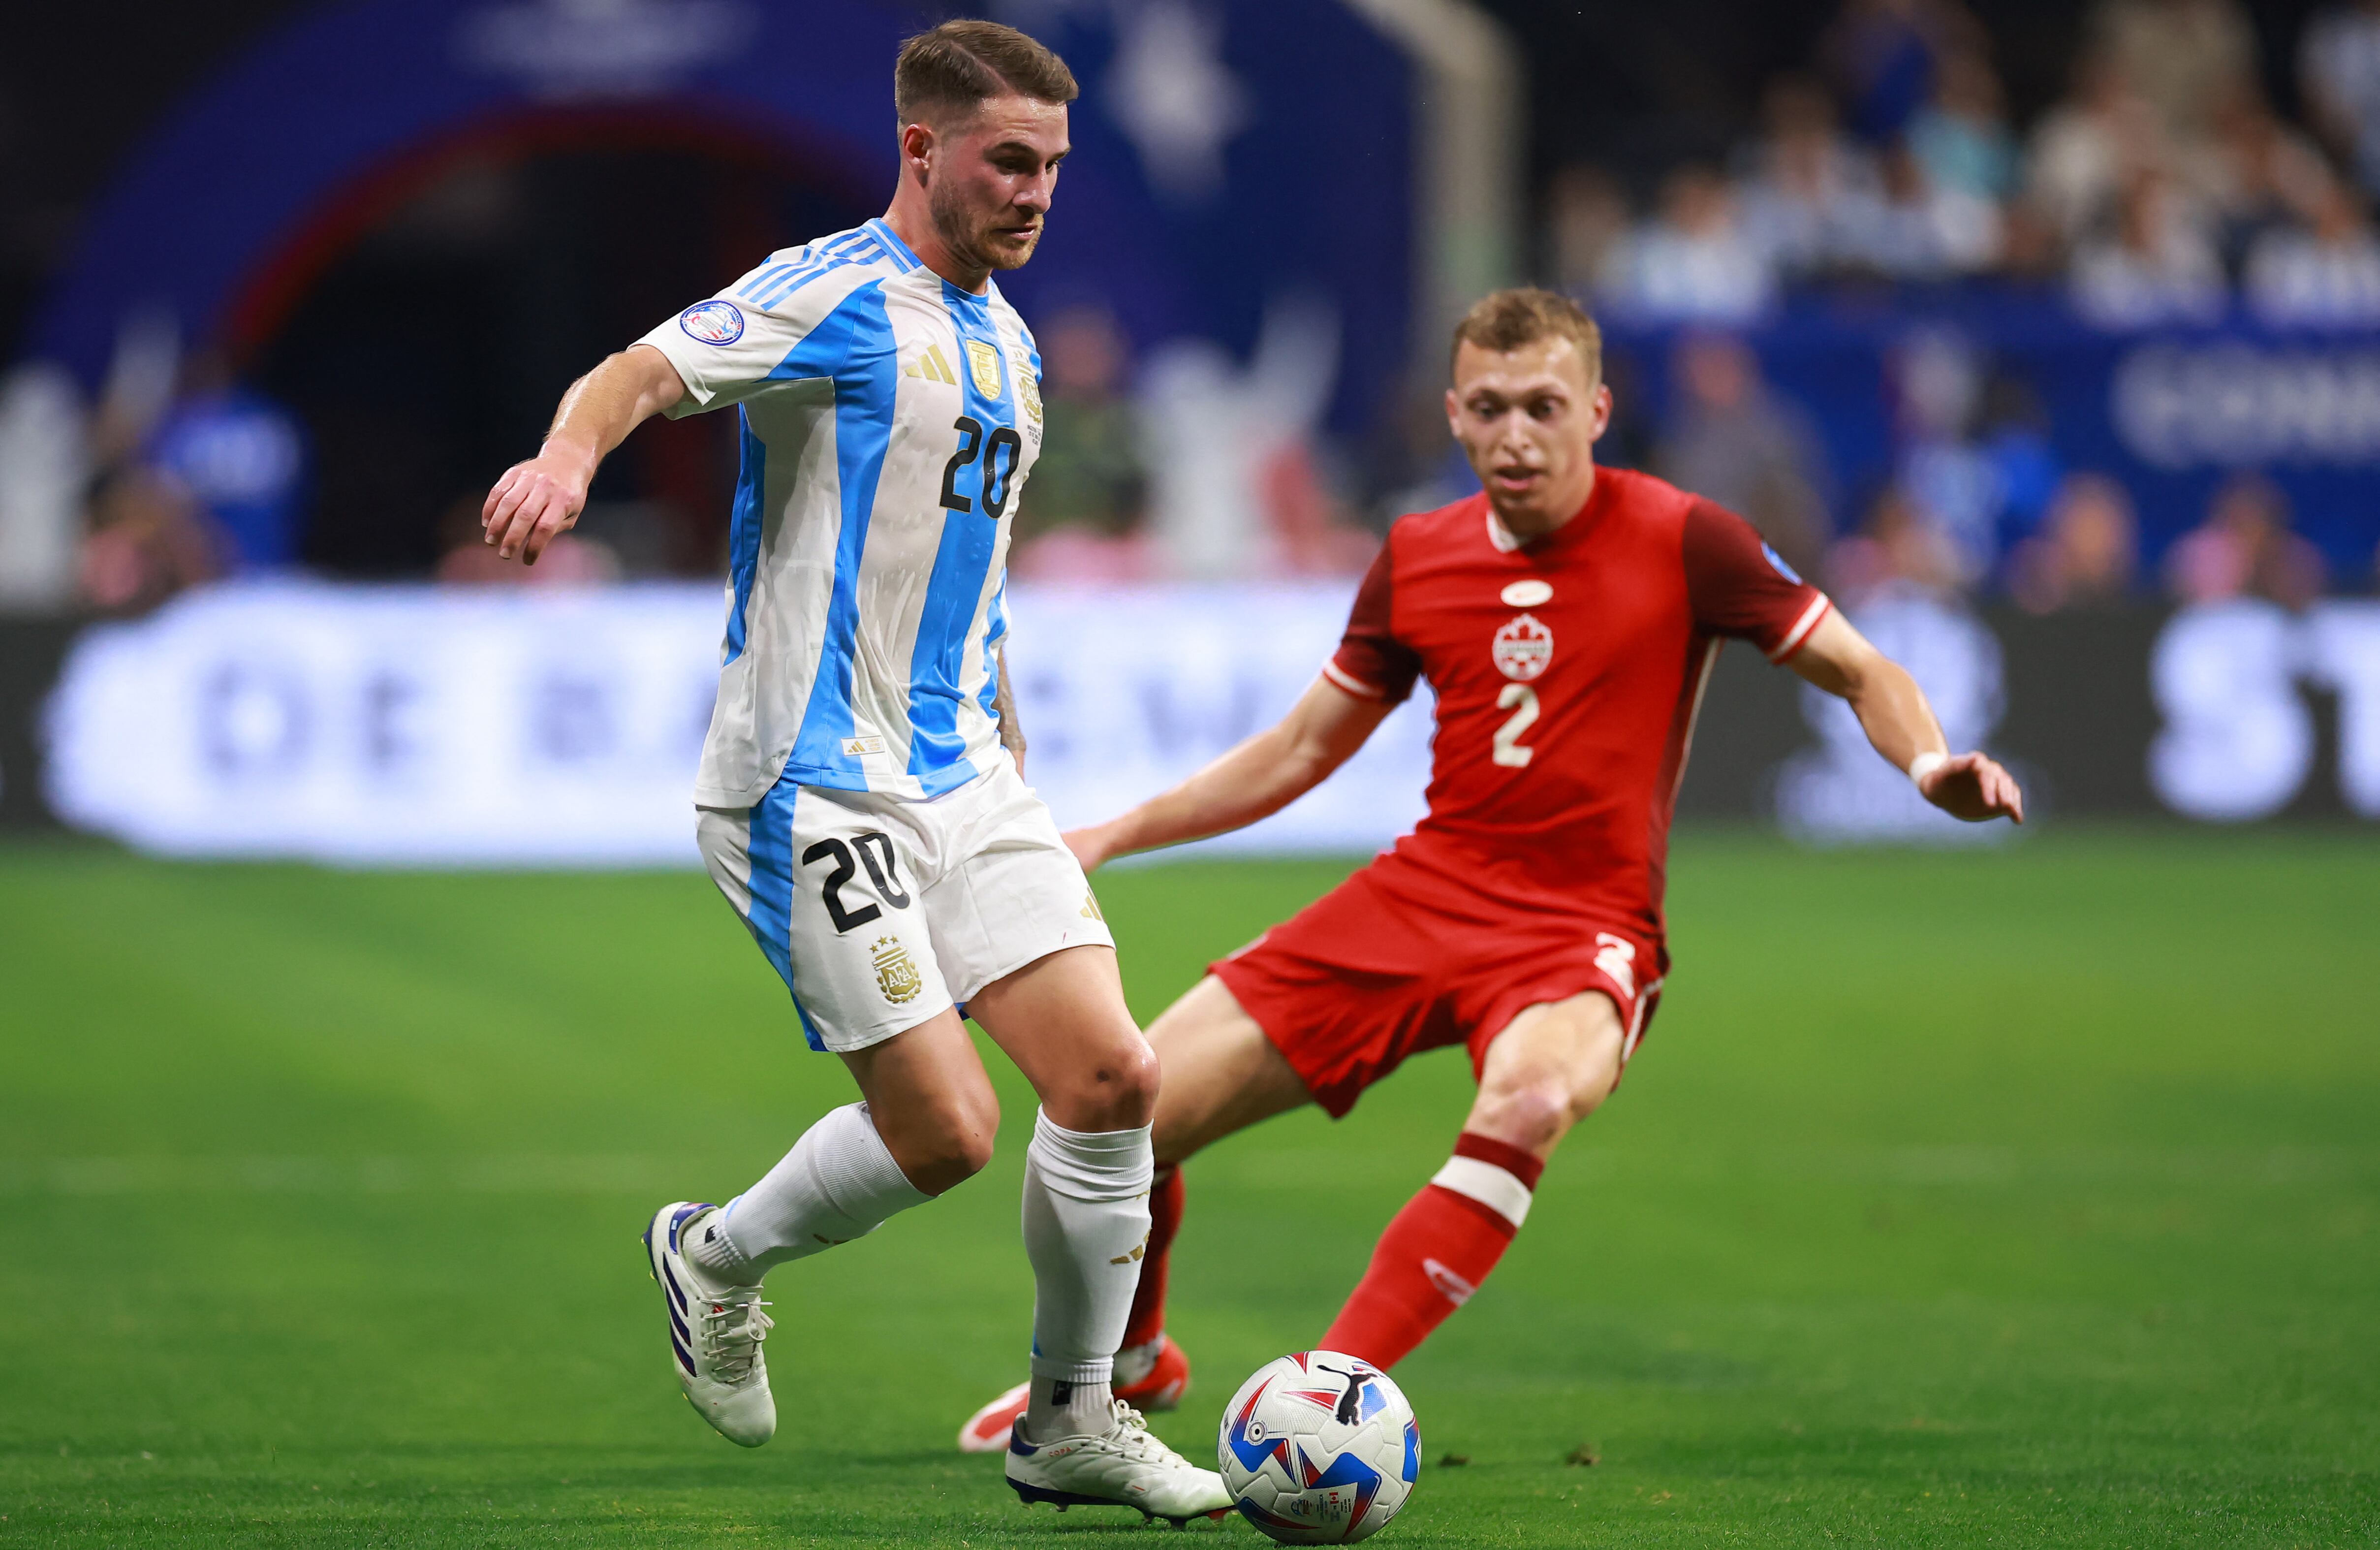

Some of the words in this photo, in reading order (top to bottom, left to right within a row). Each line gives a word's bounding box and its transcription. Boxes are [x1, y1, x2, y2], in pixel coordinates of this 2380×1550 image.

[939, 416, 1021, 519] 20
[1492, 683, 1540, 767] 2
[802, 832, 910, 934] 20
[885, 962, 913, 988] AFA
[1593, 932, 1635, 1000] 2
